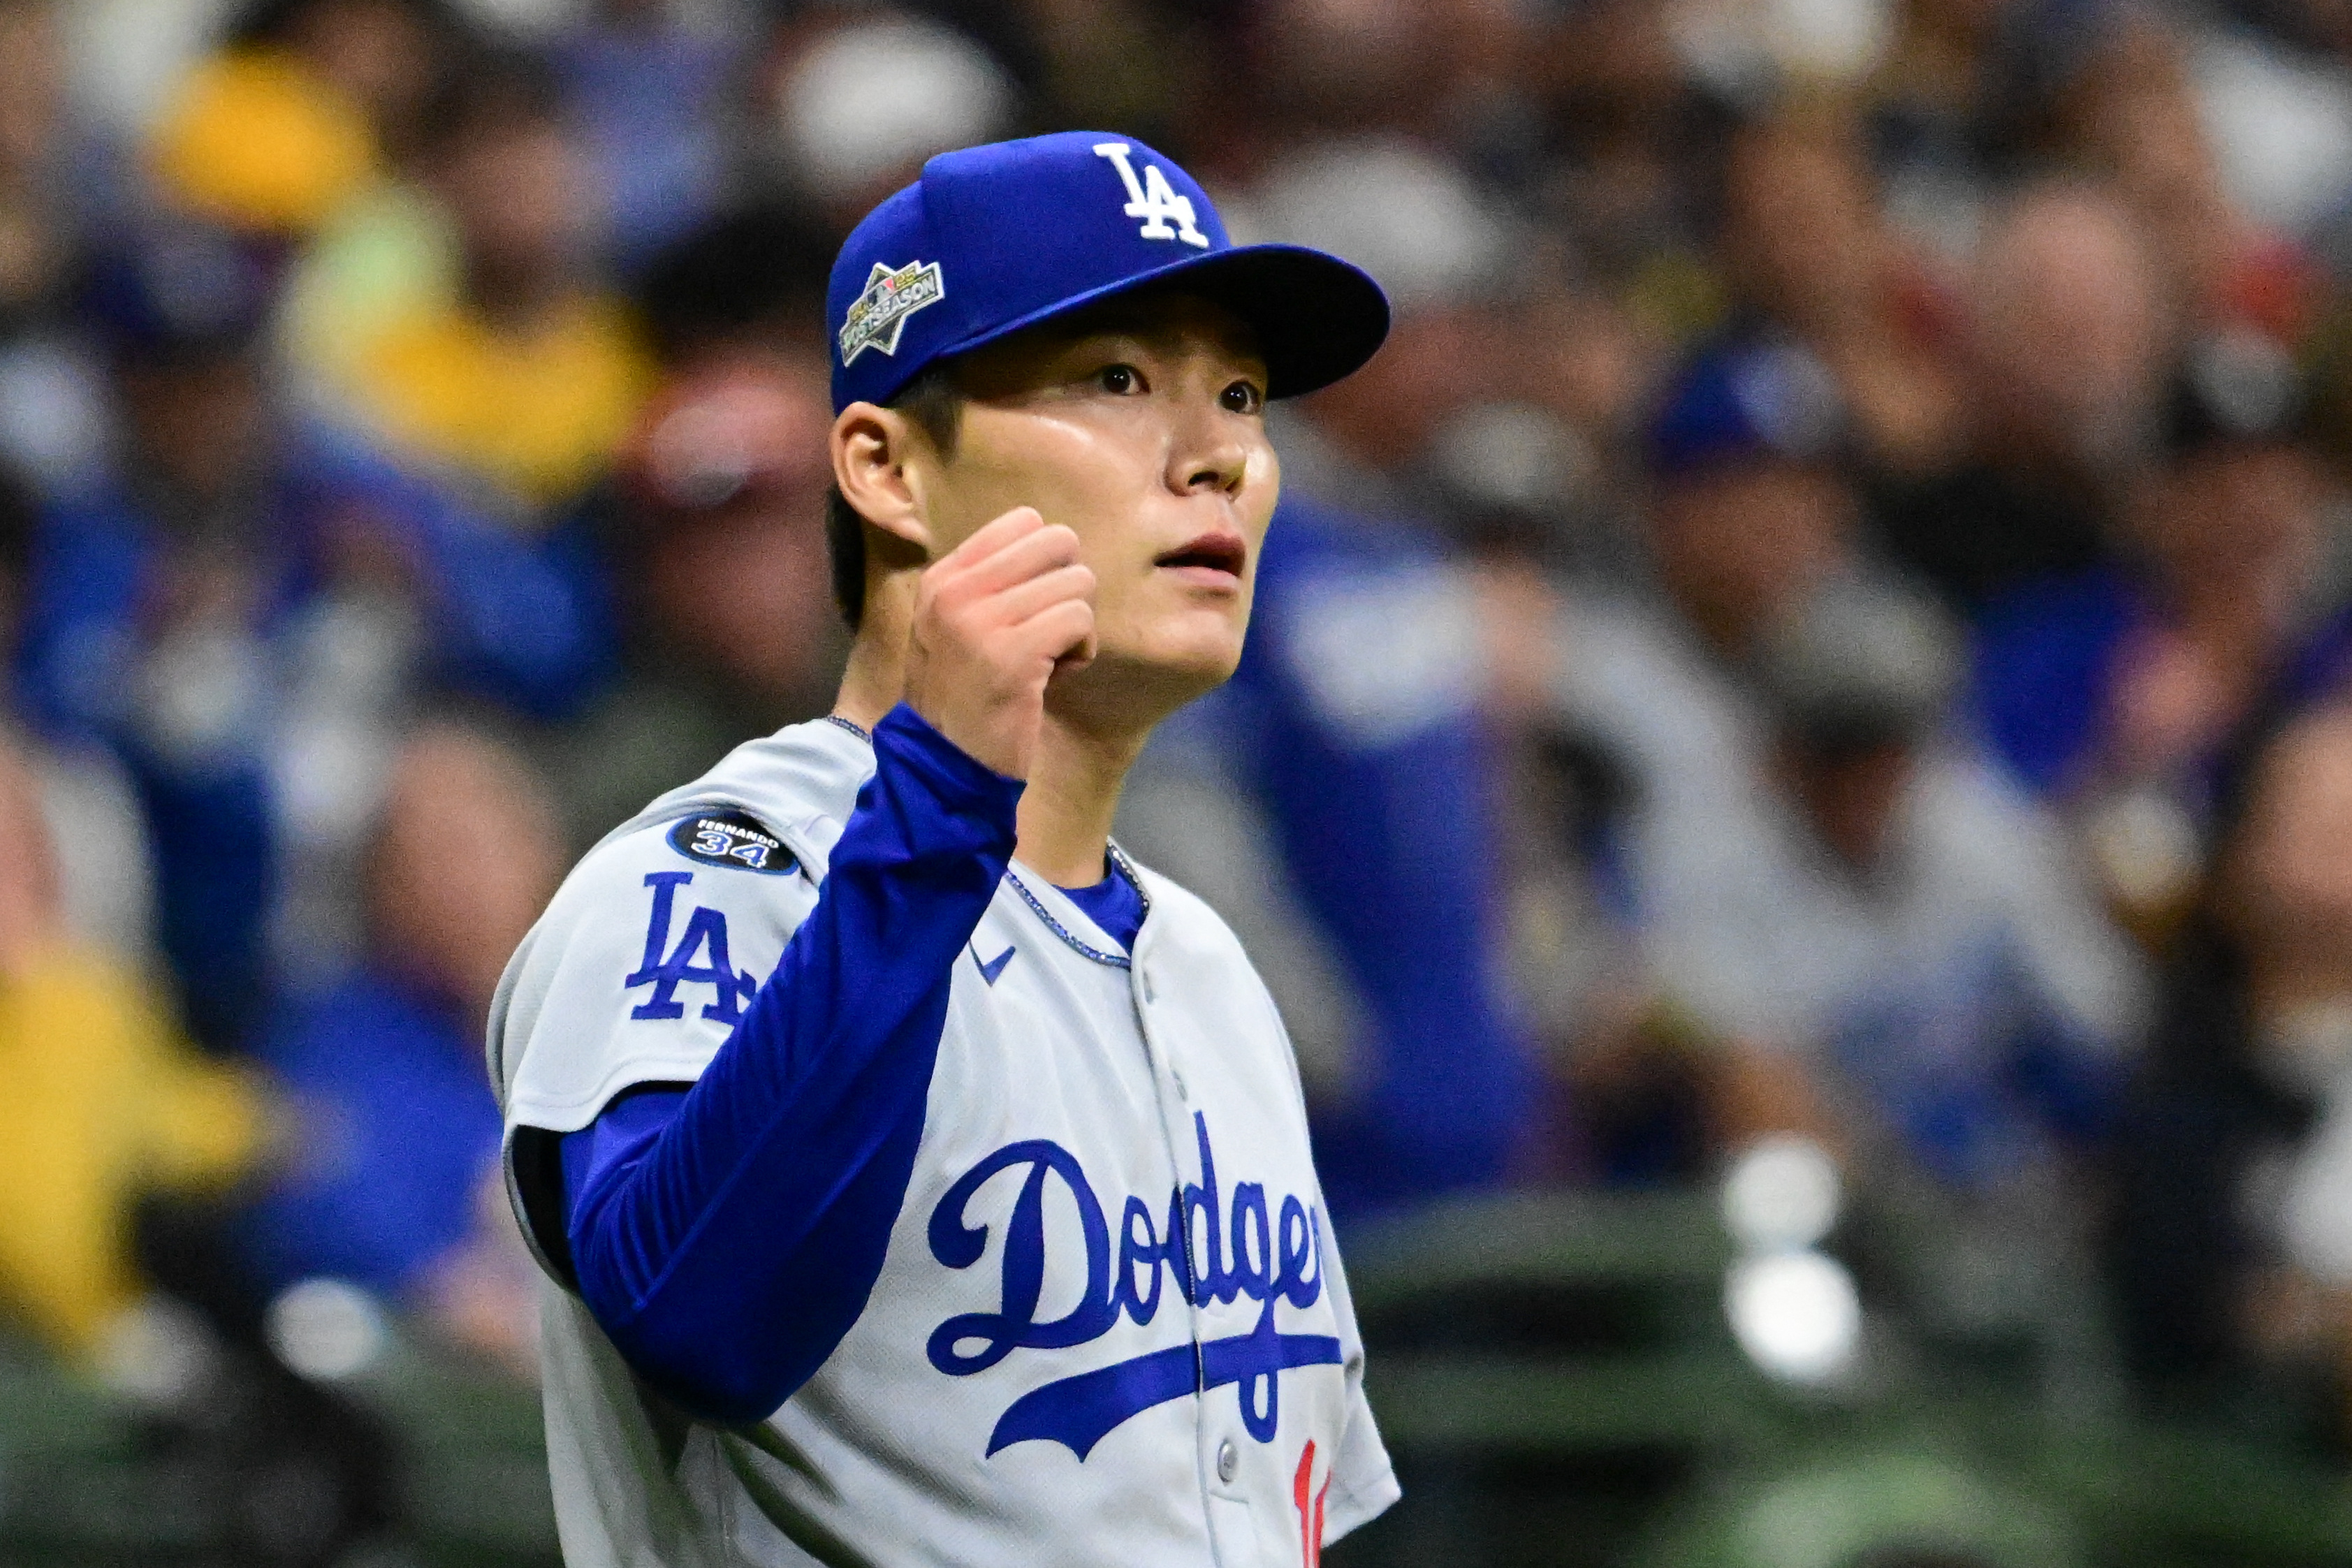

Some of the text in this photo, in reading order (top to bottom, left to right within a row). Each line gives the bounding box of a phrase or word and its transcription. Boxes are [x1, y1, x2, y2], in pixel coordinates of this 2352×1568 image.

[1093, 143, 1209, 249] LA
[690, 830, 770, 868] 34
[697, 819, 780, 849] FERNANDO
[624, 871, 757, 1026] LA
[926, 1110, 1323, 1444] Dodge
[1293, 1438, 1333, 1568] 1
